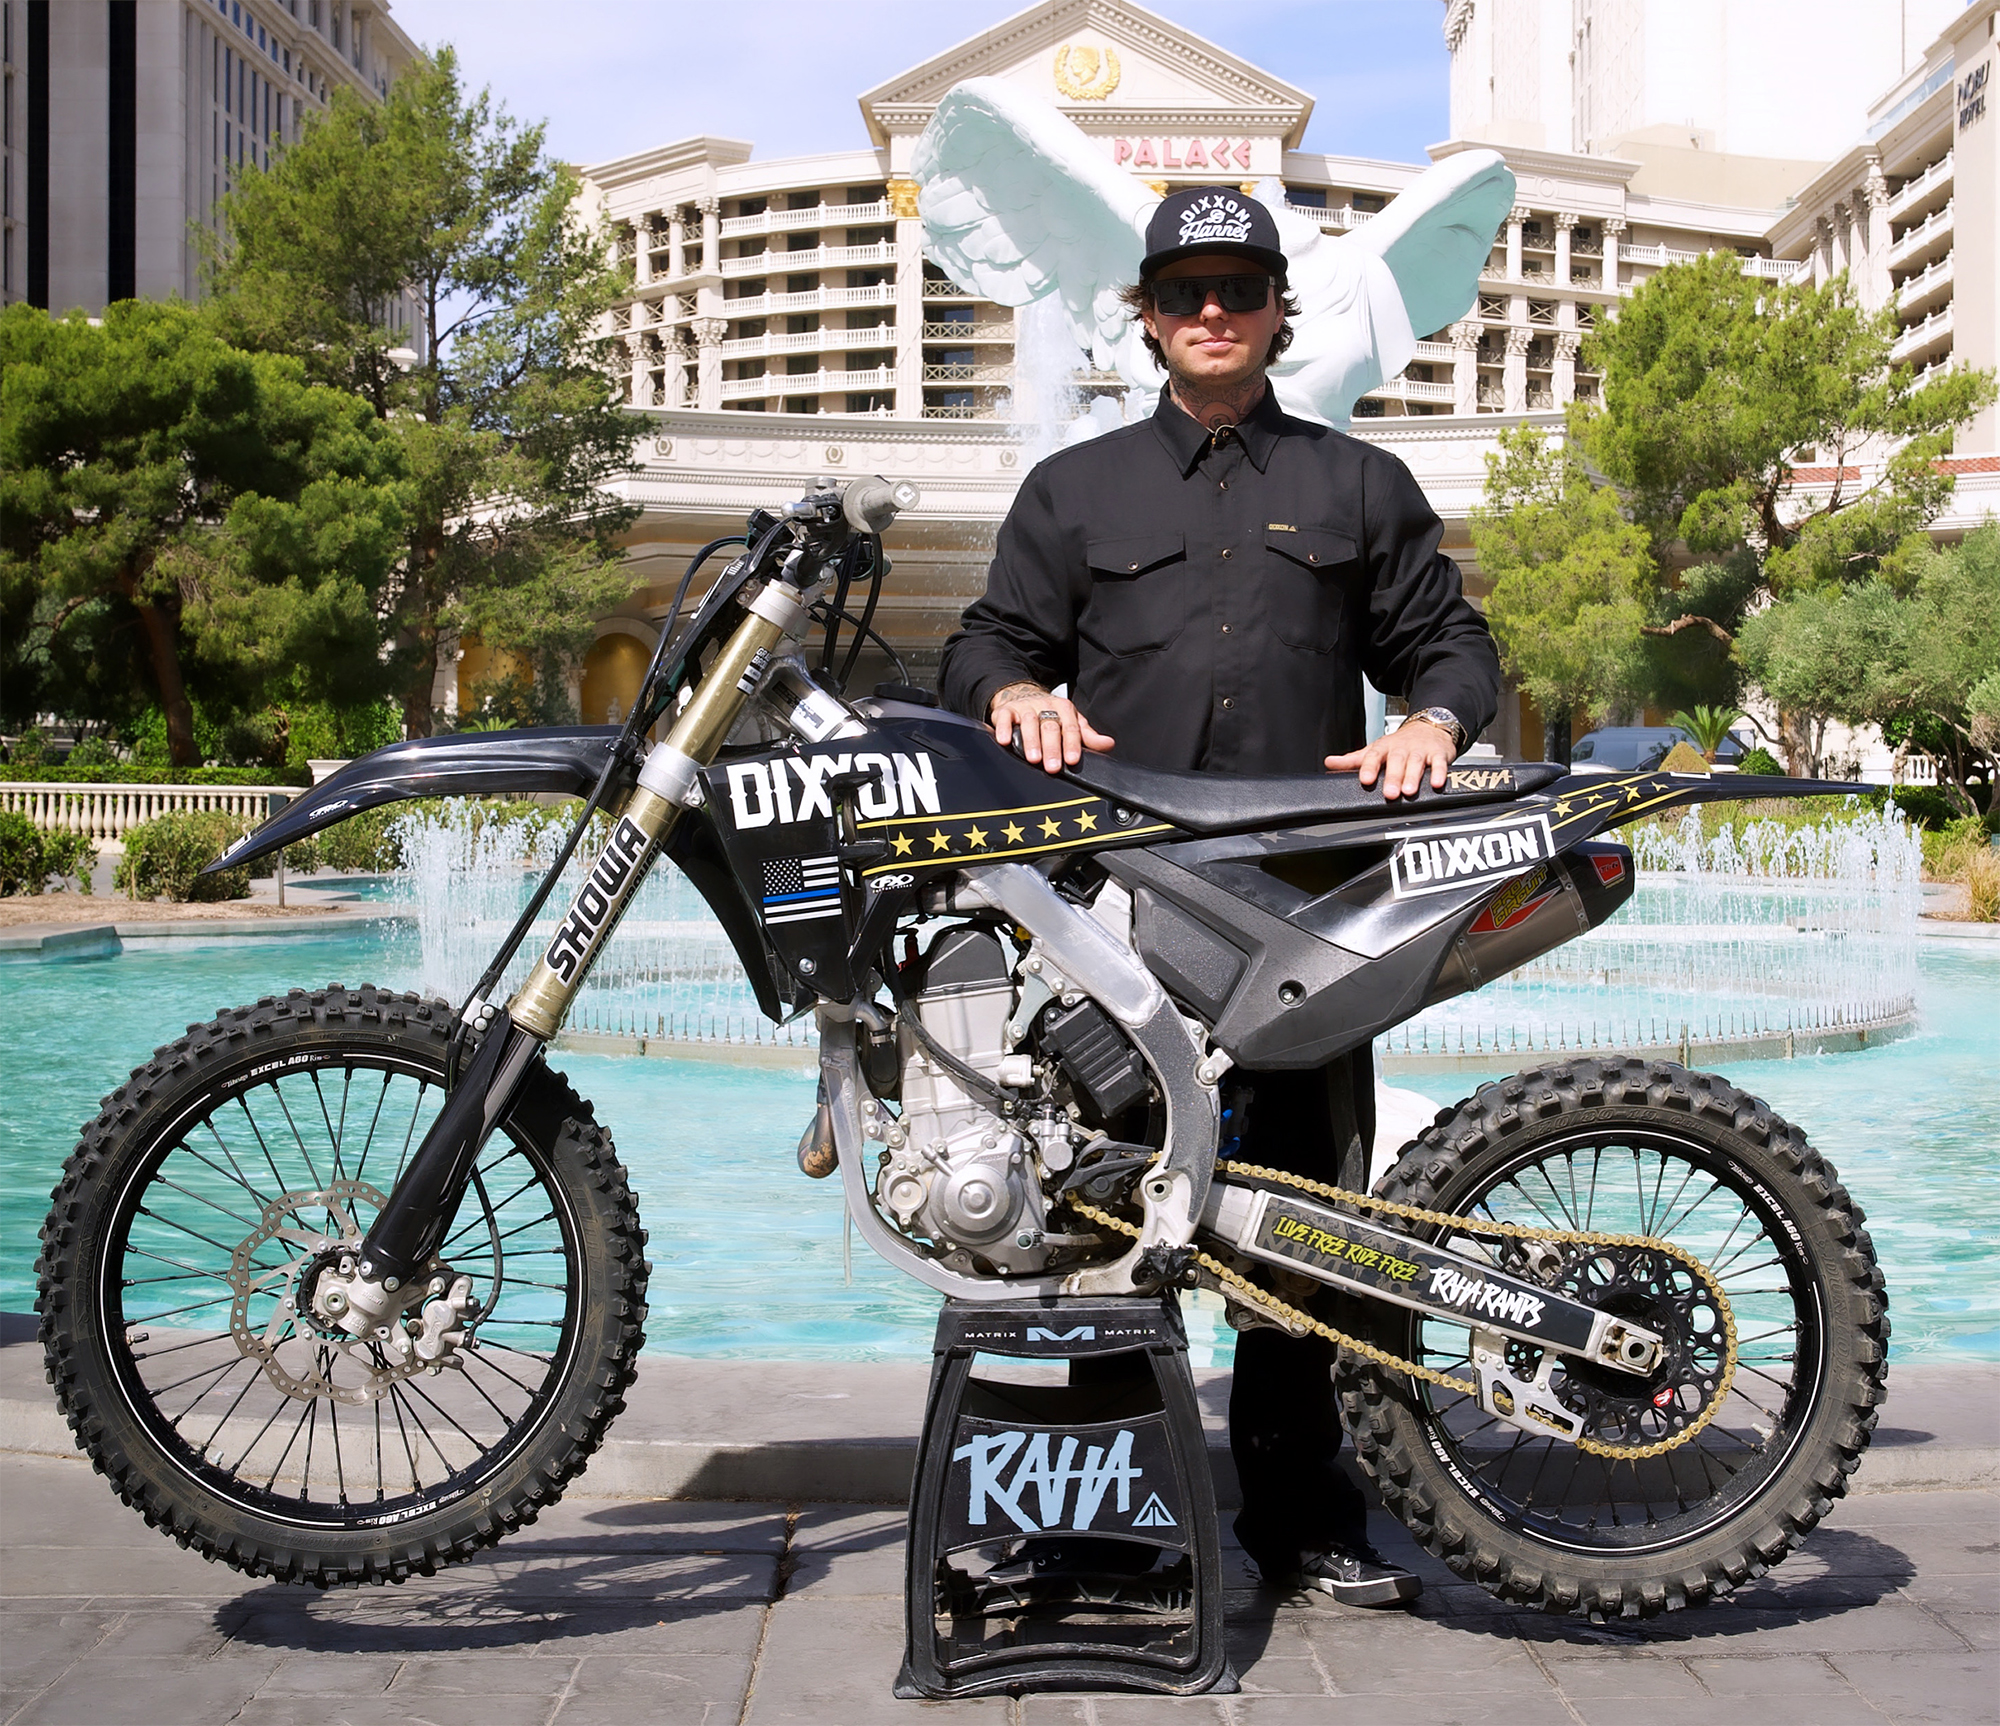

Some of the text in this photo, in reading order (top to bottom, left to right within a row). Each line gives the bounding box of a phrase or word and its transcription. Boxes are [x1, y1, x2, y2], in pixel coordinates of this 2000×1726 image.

[1957, 59, 1991, 105] NOBU
[1959, 94, 1986, 130] HOTEL
[1114, 139, 1251, 168] PALACE
[1180, 195, 1250, 223] DIXXON
[1179, 219, 1252, 246] Flannel
[1447, 769, 1513, 790] RAHA
[1404, 827, 1540, 884] DIXXON
[545, 815, 649, 985] SHOWA
[1492, 880, 1521, 915] PRO
[1495, 866, 1546, 926] CIRCUIT
[250, 1060, 286, 1077] EXCEL
[288, 1055, 309, 1066] A60
[1753, 1183, 1785, 1219] EXCEL
[1782, 1218, 1801, 1242] A60
[1273, 1217, 1420, 1281] LIVE FREE RIDE FREE
[1429, 1267, 1546, 1328] RAHA RAMPS
[1104, 1328, 1156, 1336] MATRIX
[1431, 1441, 1451, 1463] A60
[953, 1429, 1143, 1533] RAHA
[1448, 1462, 1480, 1499] EXCEL
[379, 1513, 400, 1525] A60
[401, 1502, 437, 1518] EXCEL
